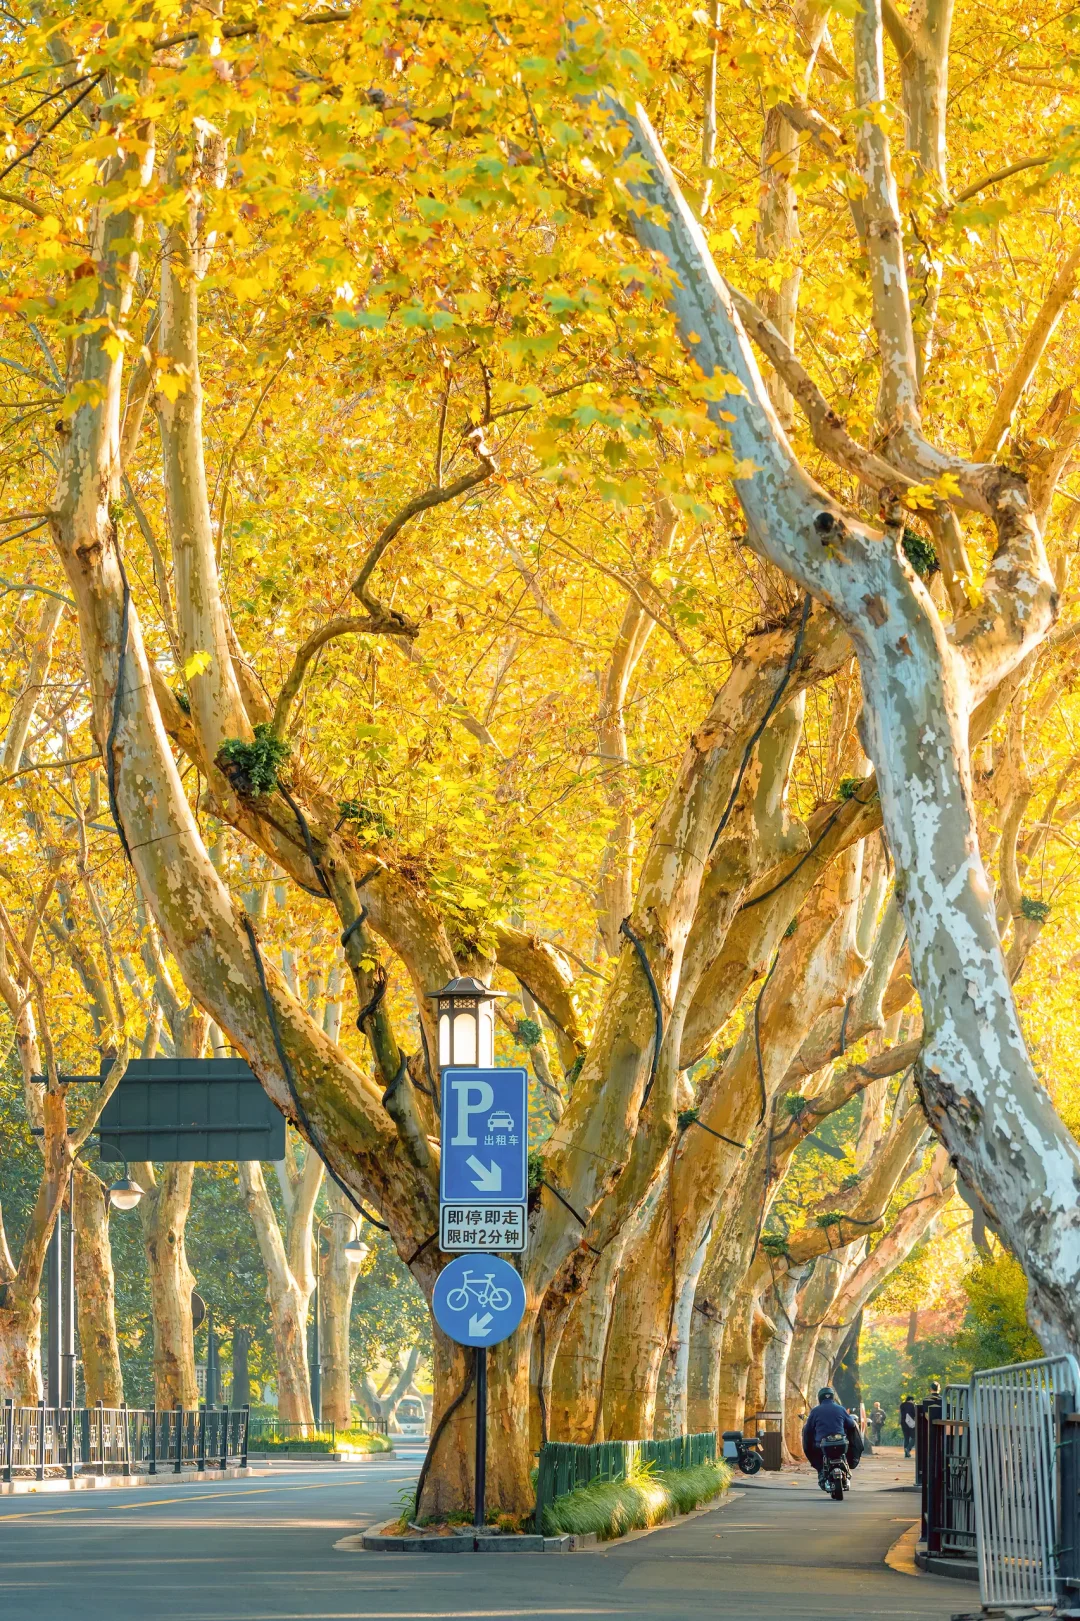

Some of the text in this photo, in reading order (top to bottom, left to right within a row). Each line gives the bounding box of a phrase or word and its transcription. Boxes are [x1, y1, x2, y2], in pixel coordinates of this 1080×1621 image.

[451, 1081, 494, 1146] P
[484, 1134, 519, 1146] 出租车
[447, 1210, 519, 1225] 即停即走
[447, 1229, 519, 1245] 限时2分钟
